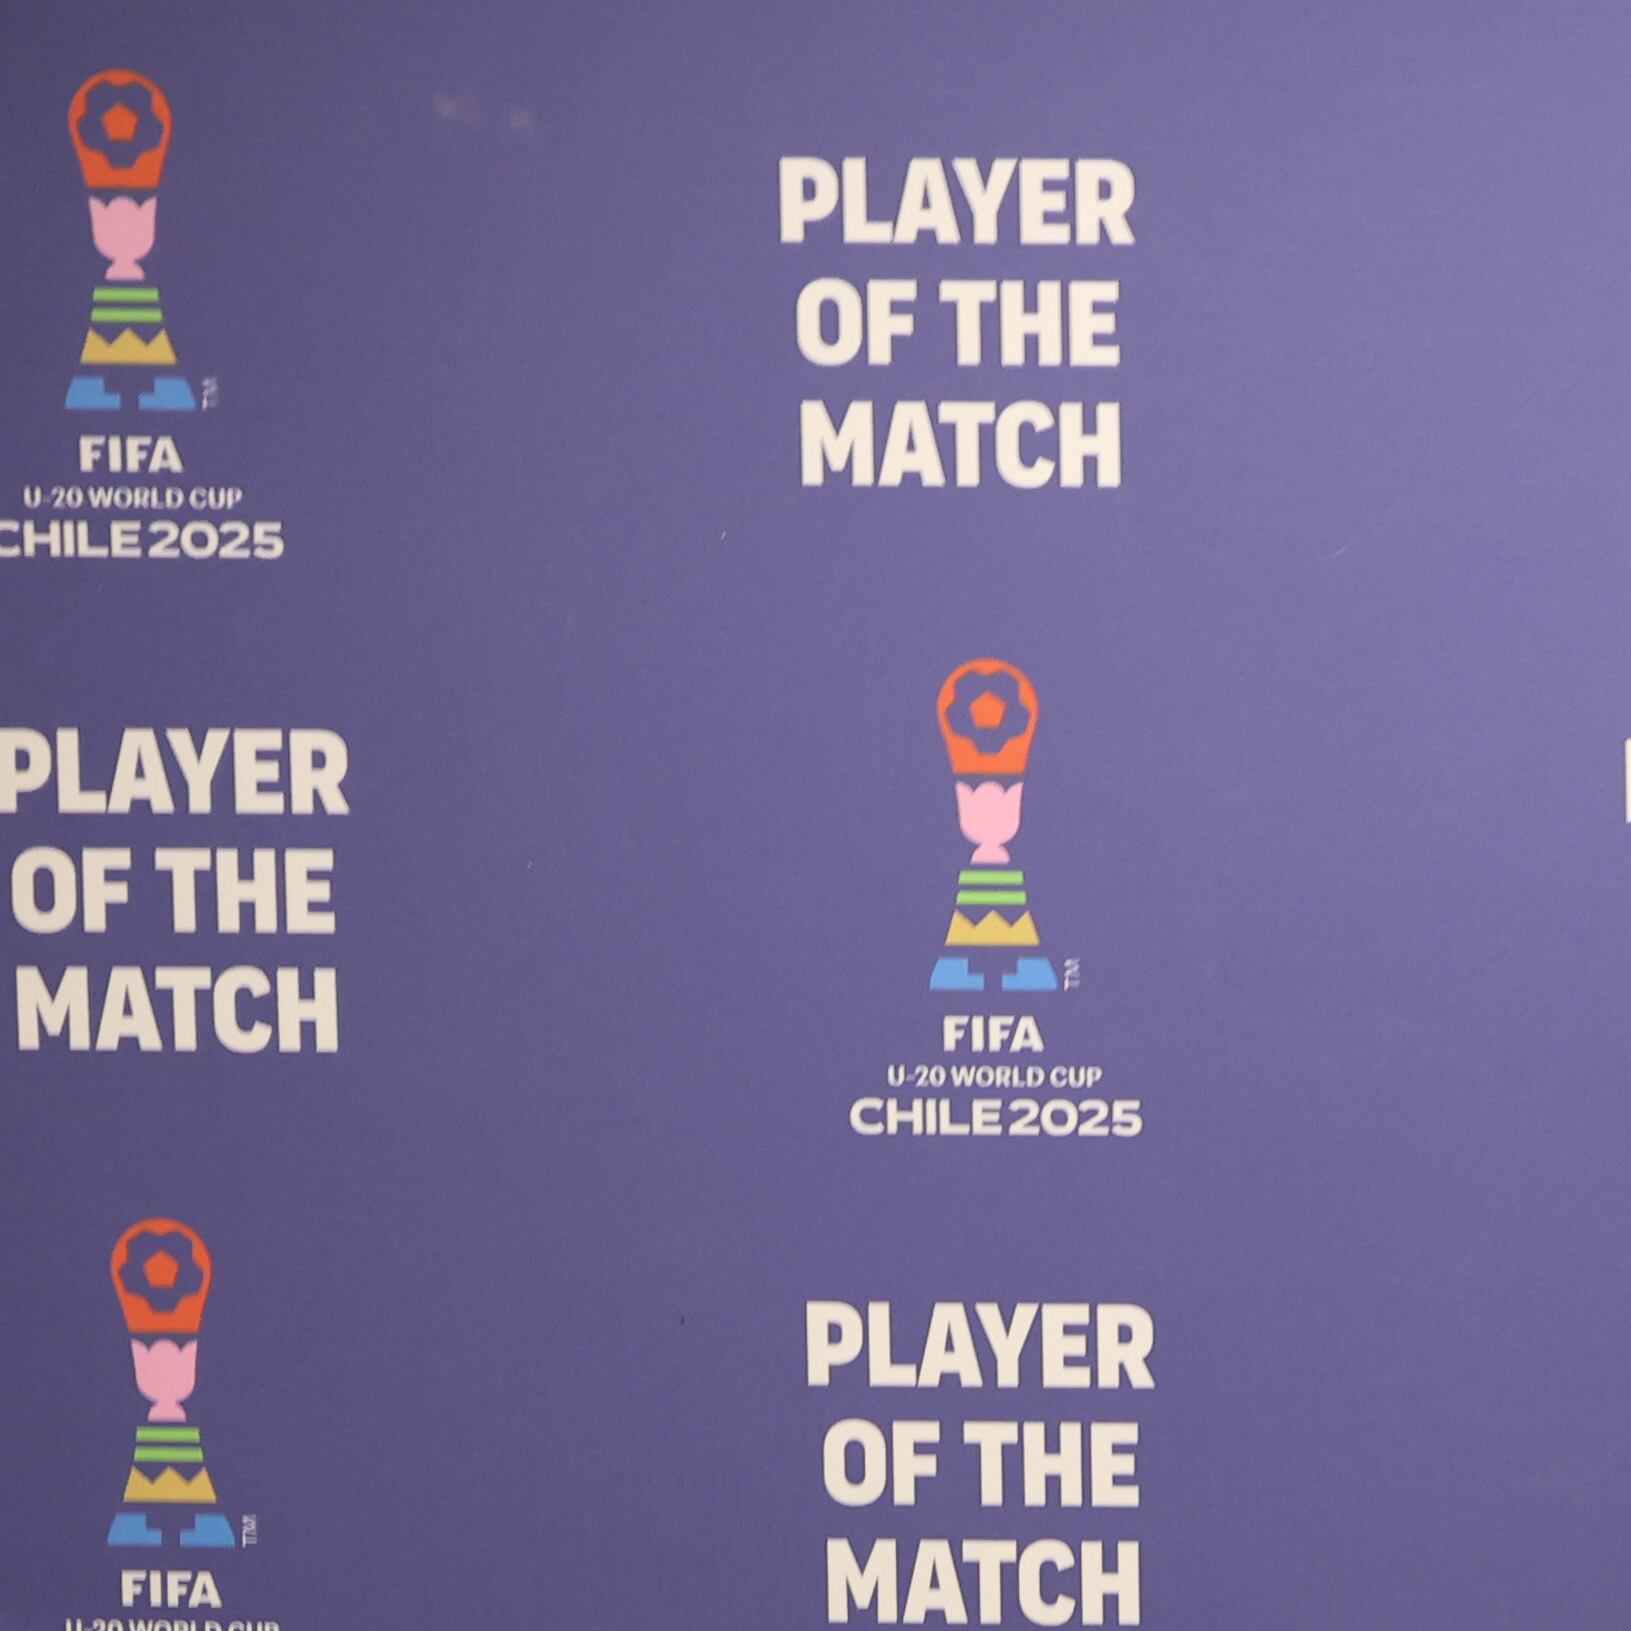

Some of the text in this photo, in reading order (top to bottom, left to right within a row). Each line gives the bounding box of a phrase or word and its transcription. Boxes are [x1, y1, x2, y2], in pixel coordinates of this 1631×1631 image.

[779, 156, 1136, 246] PLAYER
[796, 277, 1121, 367] OF THE
[79, 435, 183, 473] FIFA
[800, 399, 1122, 489] MATCH
[23, 486, 243, 510] U-20 WORLD CUP
[0, 727, 350, 815] PLAYER
[11, 846, 336, 935] OF THE
[15, 965, 339, 1054] MATCH
[943, 1015, 1044, 1053] FIFA
[887, 1064, 1103, 1088] U-20 WORLD CUP
[806, 1300, 1156, 1389] PLAYER
[823, 1418, 1140, 1508] OF THE
[121, 1570, 222, 1609] FIFA
[826, 1538, 1140, 1626] MATCH
